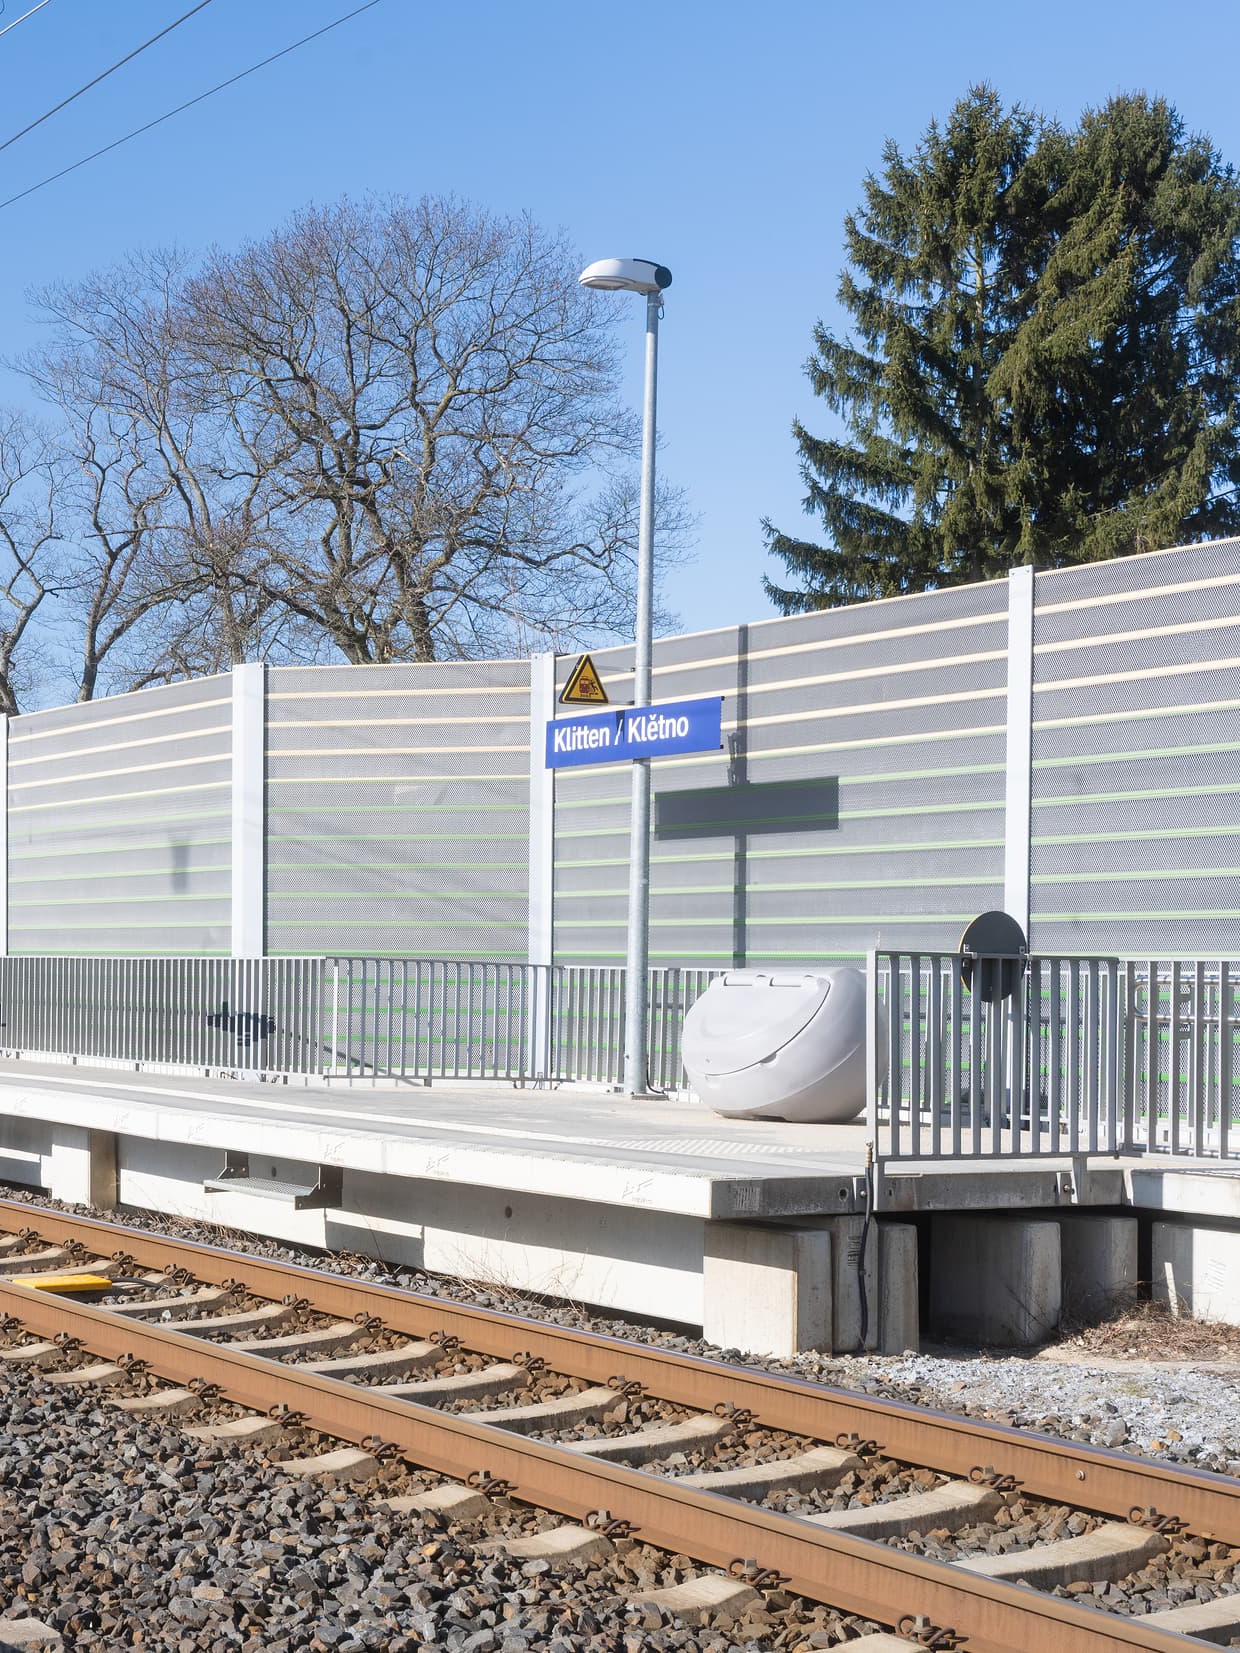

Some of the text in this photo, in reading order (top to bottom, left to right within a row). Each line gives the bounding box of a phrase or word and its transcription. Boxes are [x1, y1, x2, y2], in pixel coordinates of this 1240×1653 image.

[553, 713, 689, 753] Klitten / Klětno
